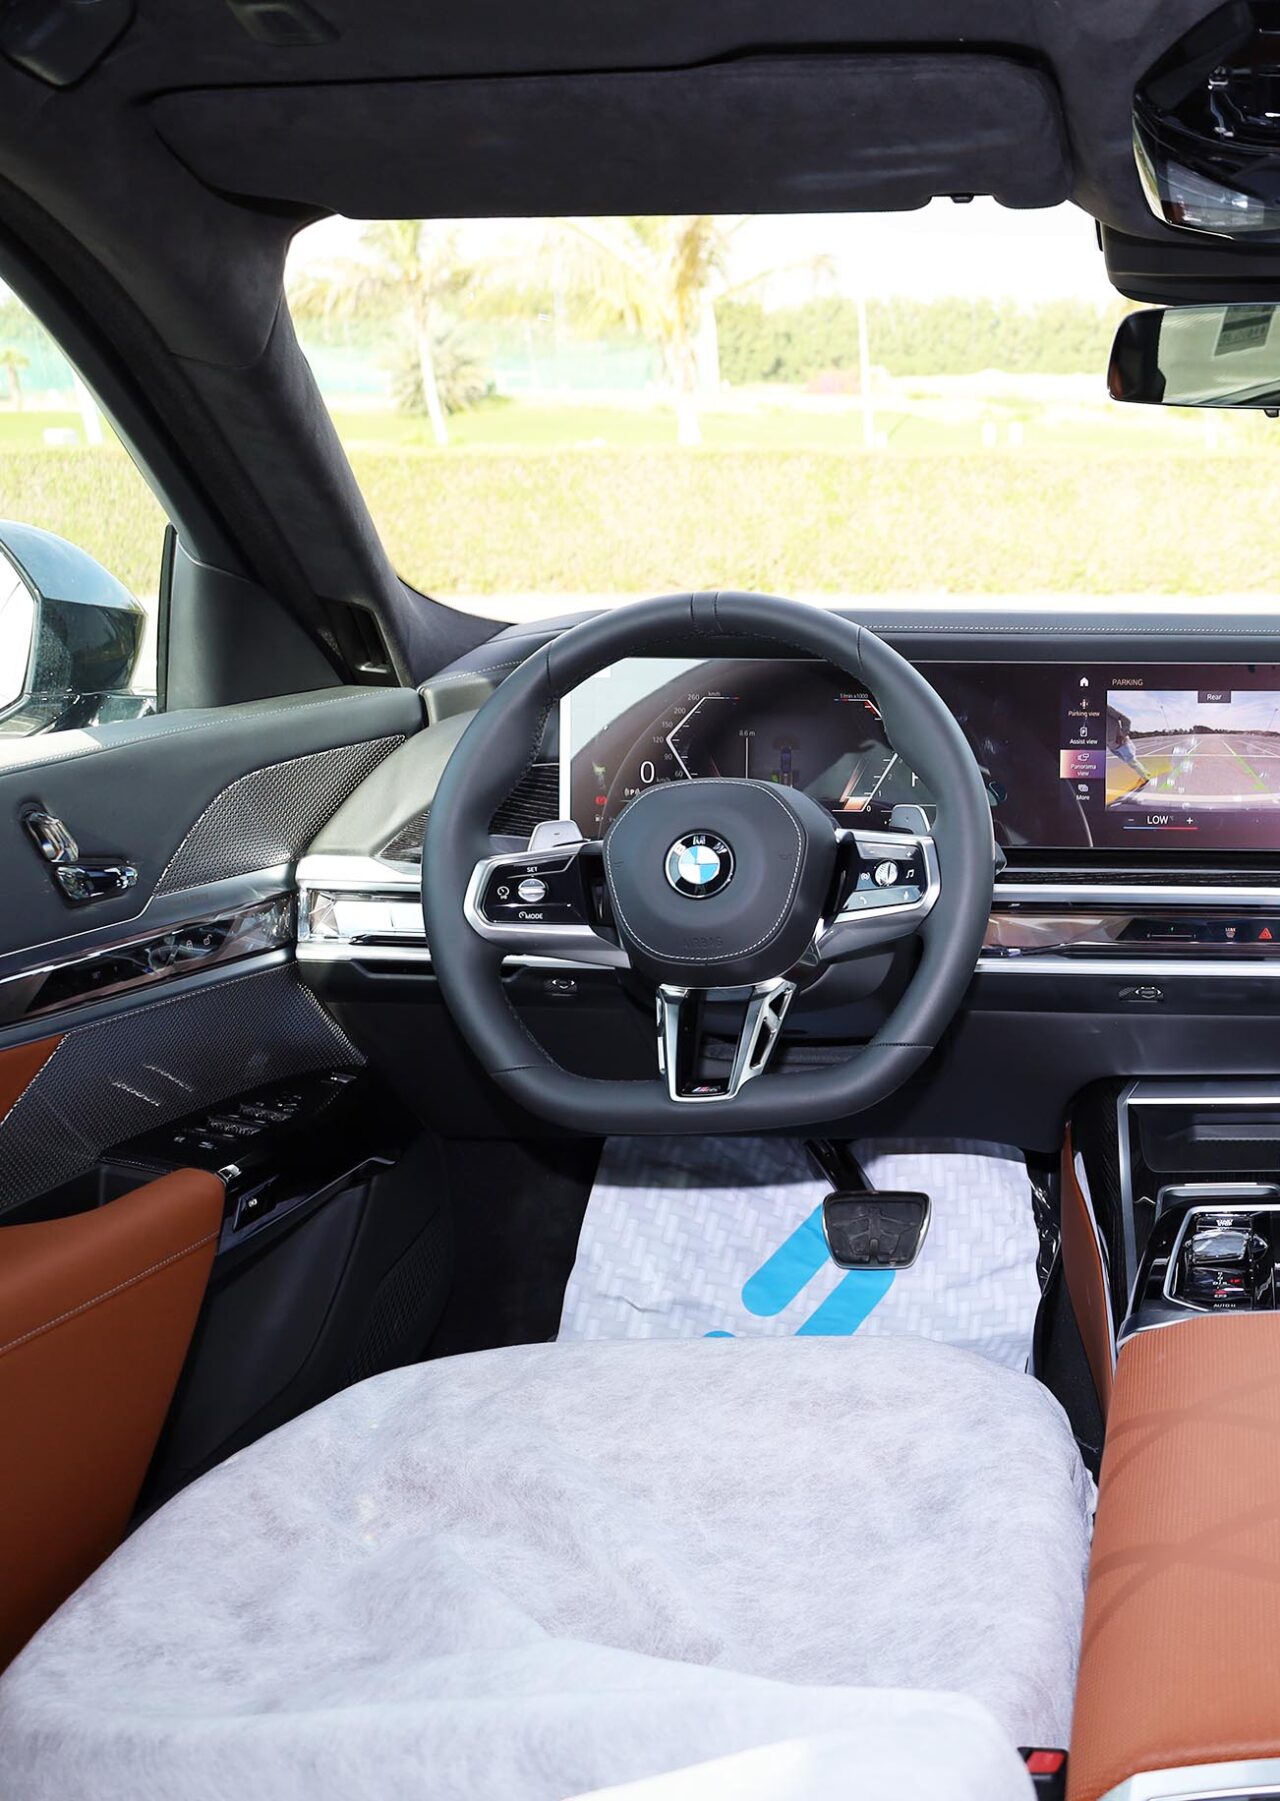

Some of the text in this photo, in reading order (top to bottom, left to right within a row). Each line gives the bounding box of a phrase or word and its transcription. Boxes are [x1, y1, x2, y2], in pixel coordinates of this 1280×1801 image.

[1111, 678, 1144, 686] PARKING
[687, 693, 700, 701] 260
[1206, 693, 1222, 701] Rear
[673, 707, 686, 715] 200
[662, 721, 673, 729] 150
[640, 760, 655, 784] 0
[674, 770, 684, 778] 60
[866, 805, 872, 813] 0
[1146, 815, 1169, 825] LOW
[525, 912, 544, 920] MODE
